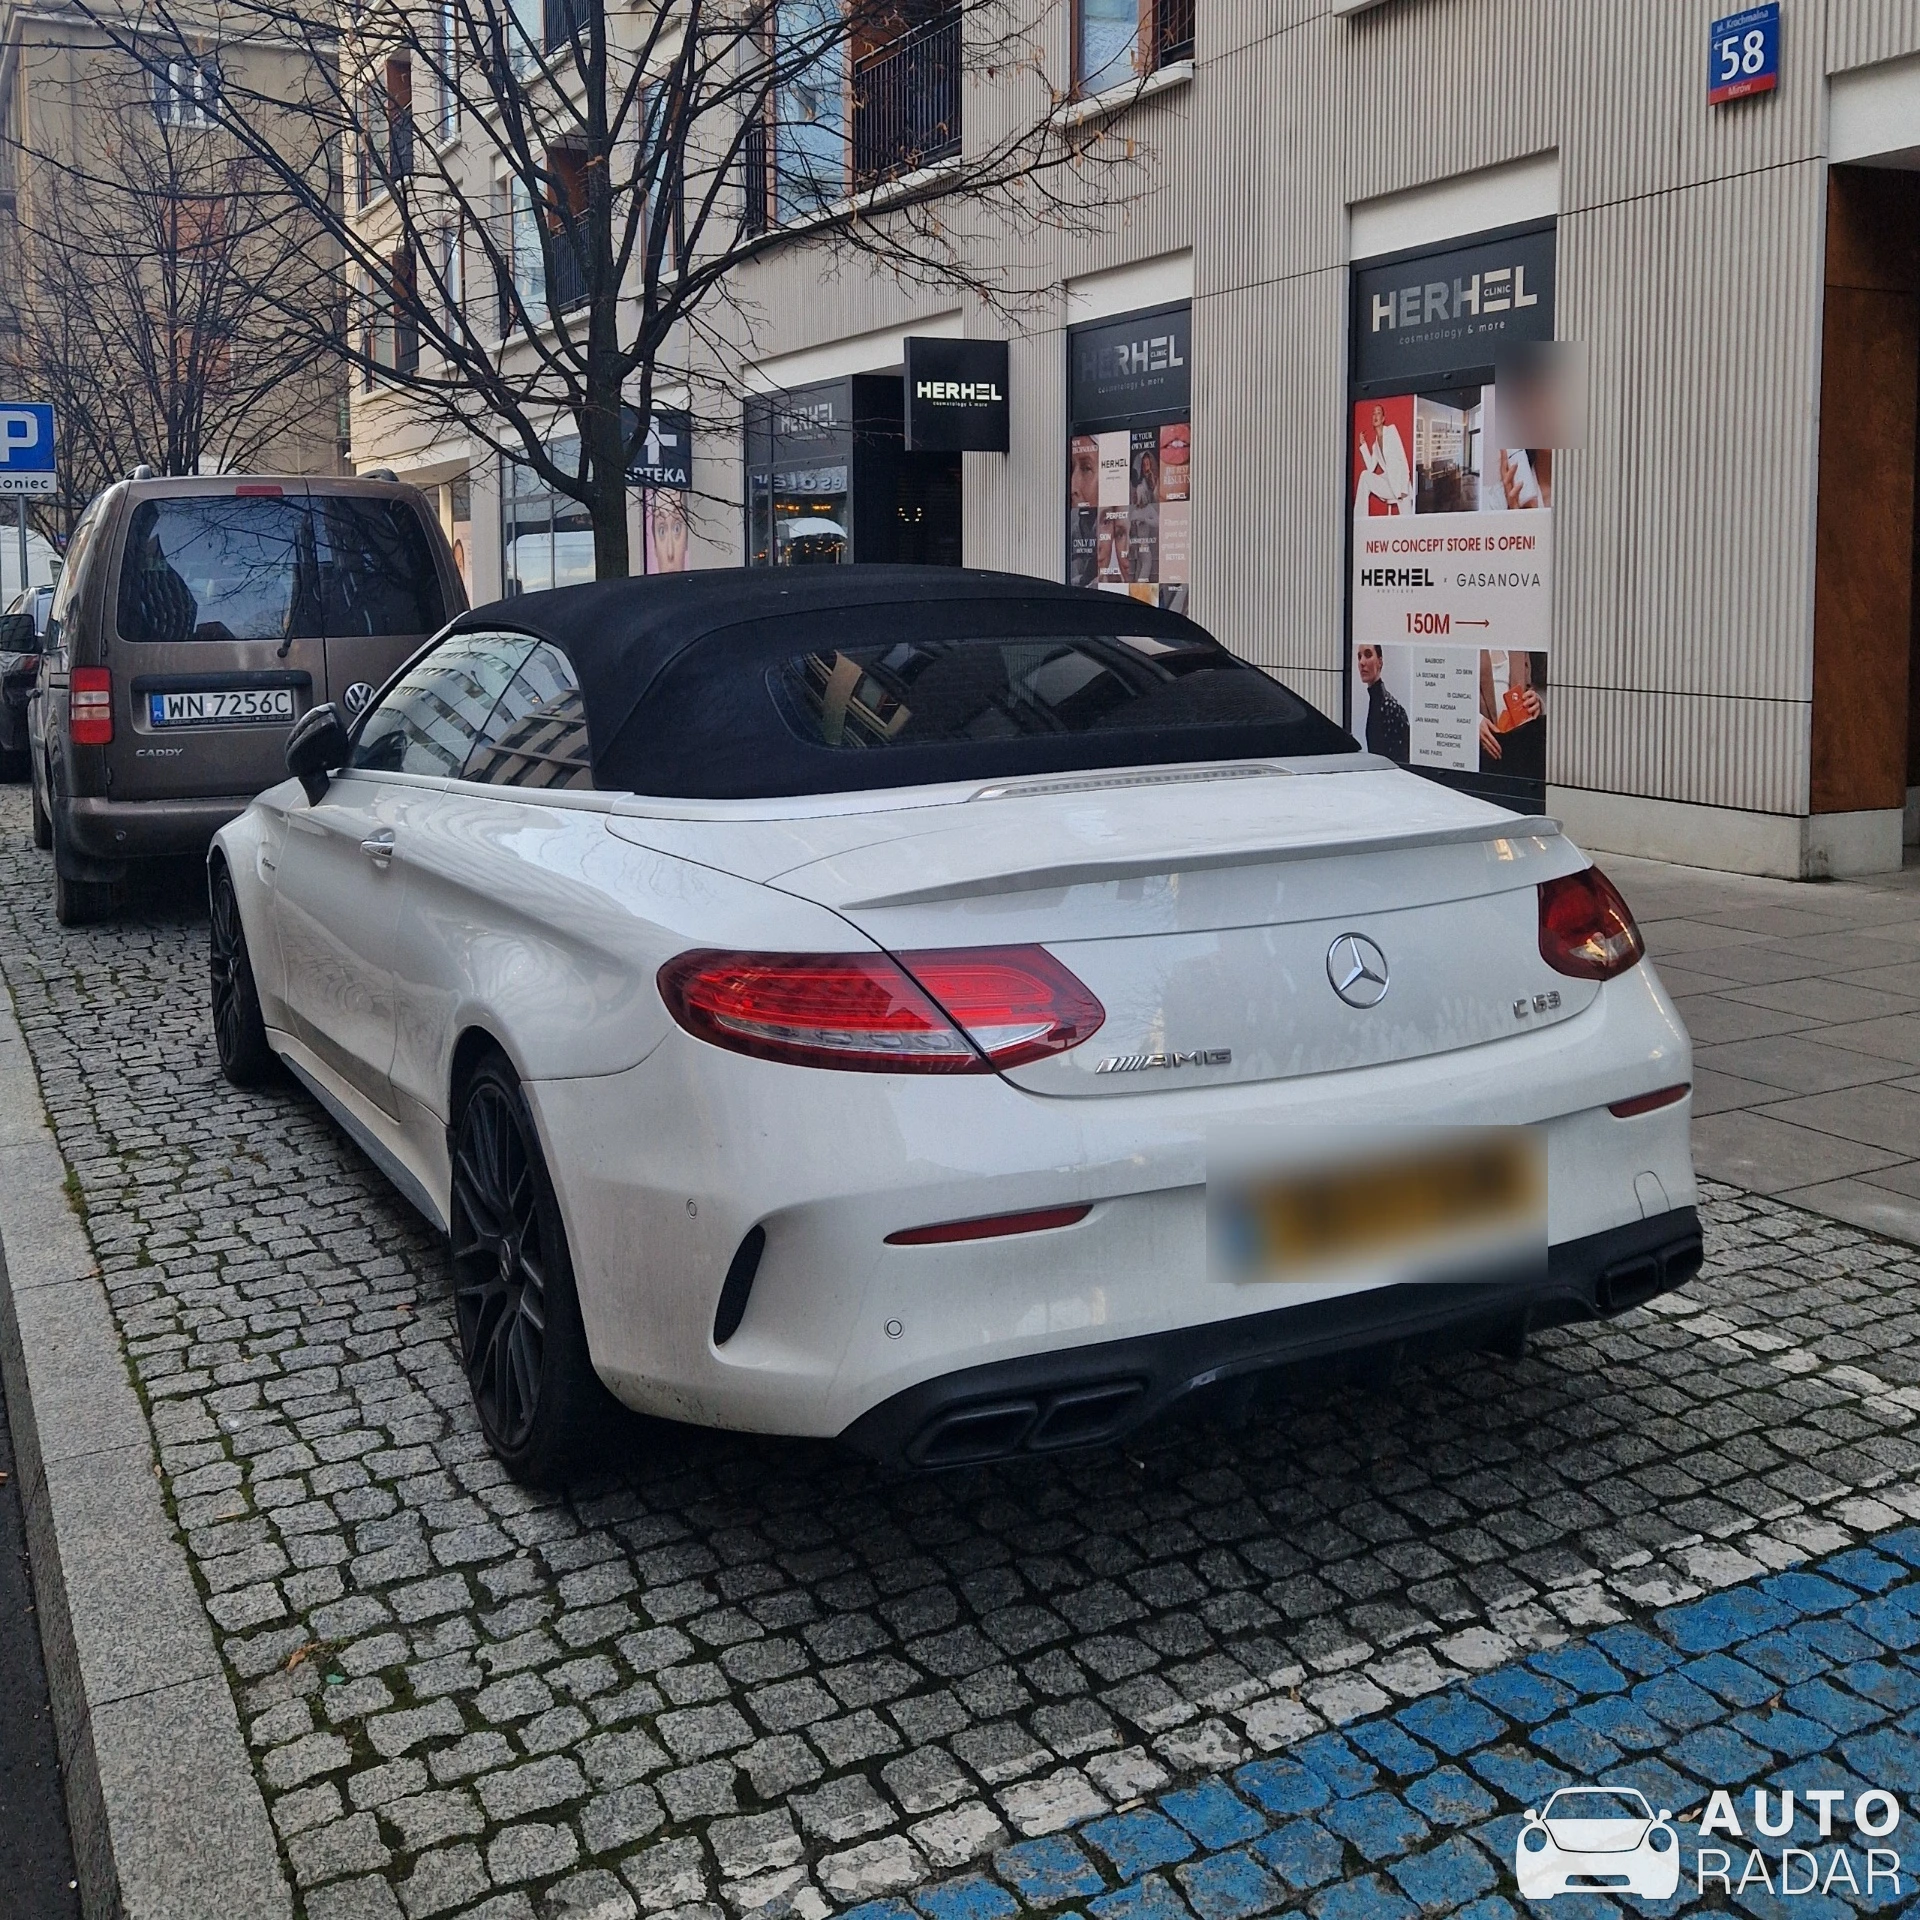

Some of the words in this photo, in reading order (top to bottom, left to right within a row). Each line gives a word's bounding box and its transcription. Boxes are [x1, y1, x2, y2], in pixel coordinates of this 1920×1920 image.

[1721, 29, 1764, 80] 58
[1728, 82, 1752, 96] Mirów
[1372, 265, 1538, 333] HERHEL
[1483, 284, 1511, 297] CLINIC
[1399, 327, 1463, 345] cosmetology
[1467, 325, 1474, 334] &
[1479, 320, 1506, 332] more
[917, 381, 1002, 401] HERHEL
[1148, 377, 1164, 386] more
[0, 410, 38, 462] P
[1101, 458, 1128, 469] HERHEL
[0, 477, 48, 489] oniec
[1106, 511, 1129, 520] PERFECT
[1099, 533, 1111, 541] SKIN
[1366, 540, 1389, 553] NEW
[1392, 538, 1444, 553] CONCEPT
[1447, 537, 1481, 552] STORE
[1485, 536, 1495, 551] IS
[1498, 535, 1536, 550] OPEN!
[1361, 568, 1434, 586] HERHEL
[1456, 573, 1541, 587] GASANOVA
[1406, 612, 1450, 635] 150M
[168, 693, 204, 718] WN
[213, 692, 290, 716] 7256C
[135, 748, 184, 757] CADDY
[1512, 999, 1528, 1019] C
[1532, 990, 1562, 1014] 63
[1144, 1048, 1232, 1069] AMG
